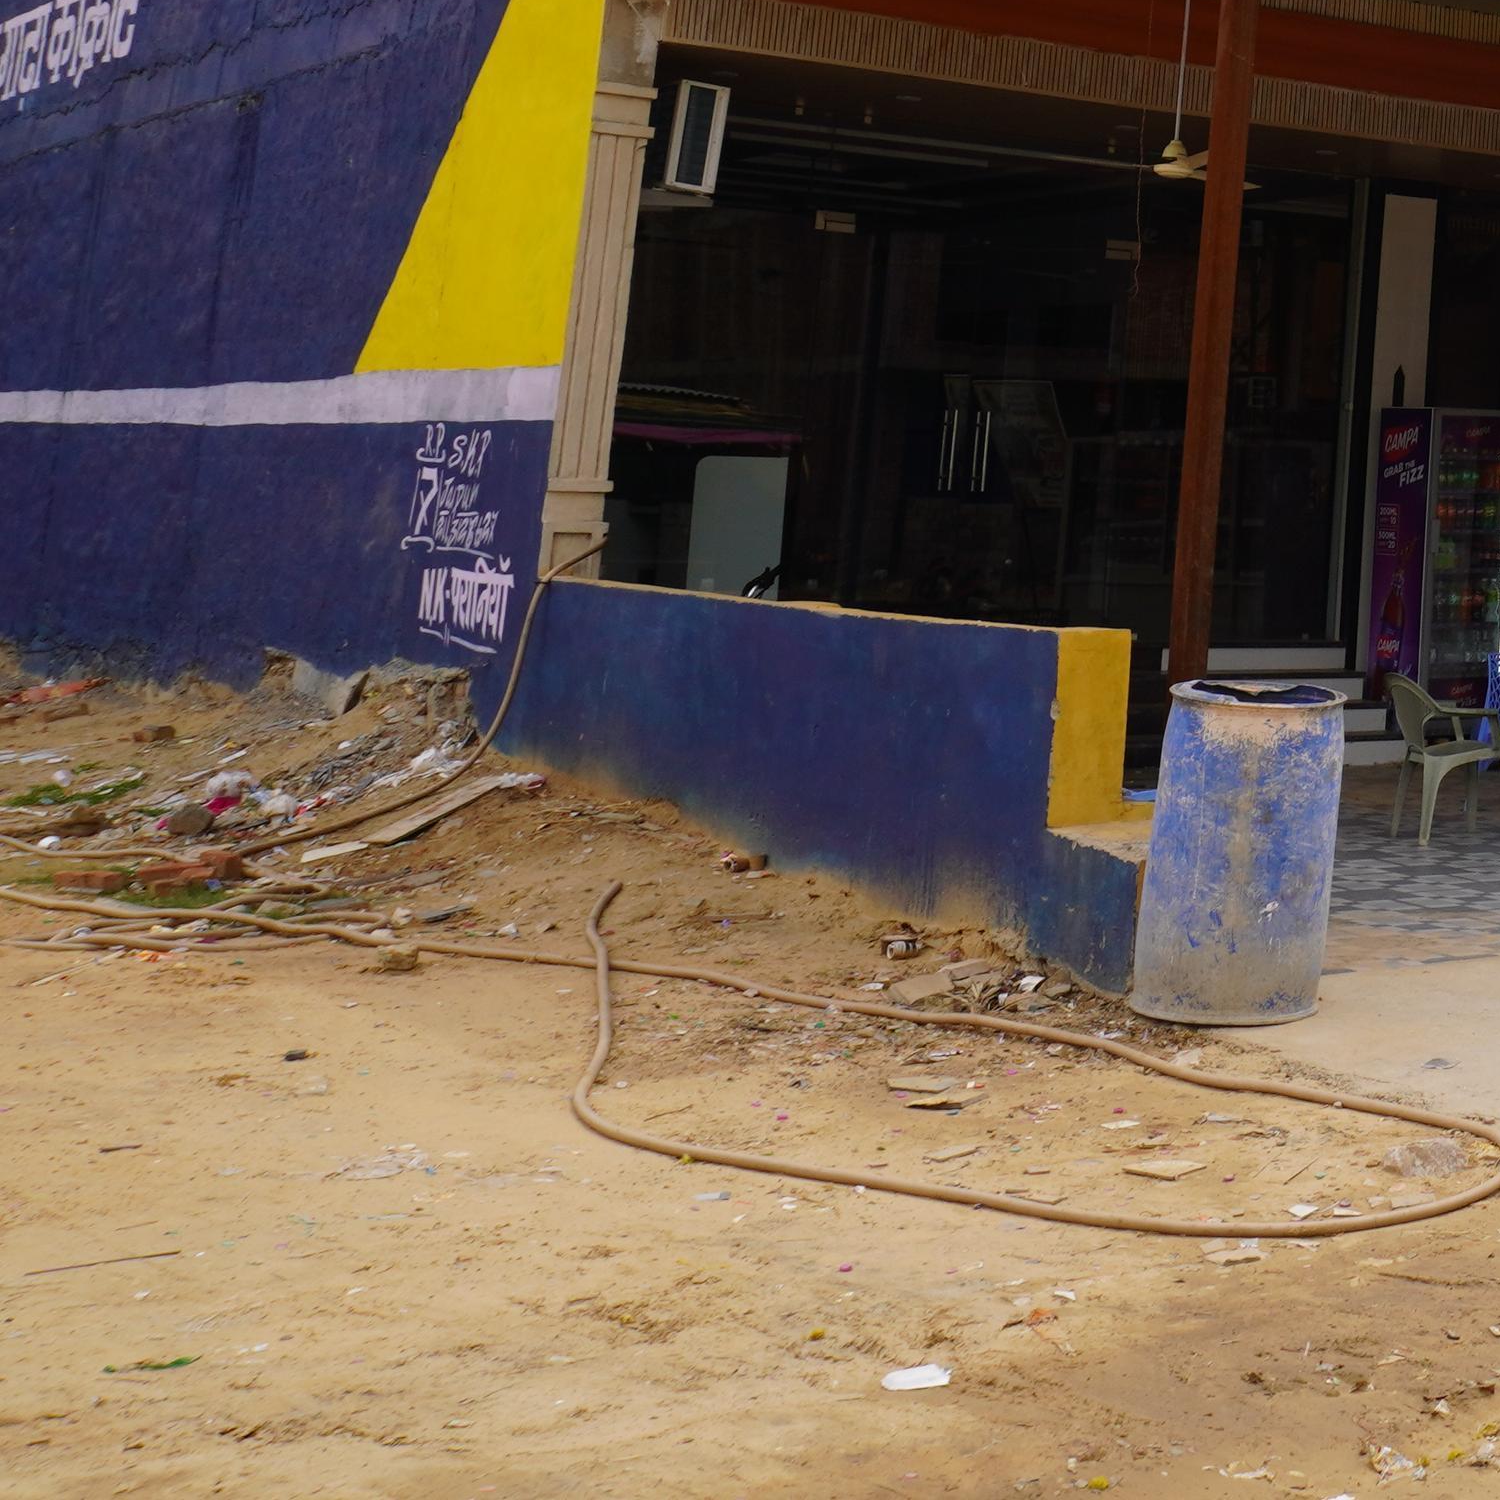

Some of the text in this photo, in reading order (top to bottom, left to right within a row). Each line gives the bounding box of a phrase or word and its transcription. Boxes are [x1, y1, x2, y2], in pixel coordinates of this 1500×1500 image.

[1385, 426, 1420, 453] CAMPA
[1384, 461, 1404, 478] GRAB
[1399, 464, 1425, 488] FIZZ
